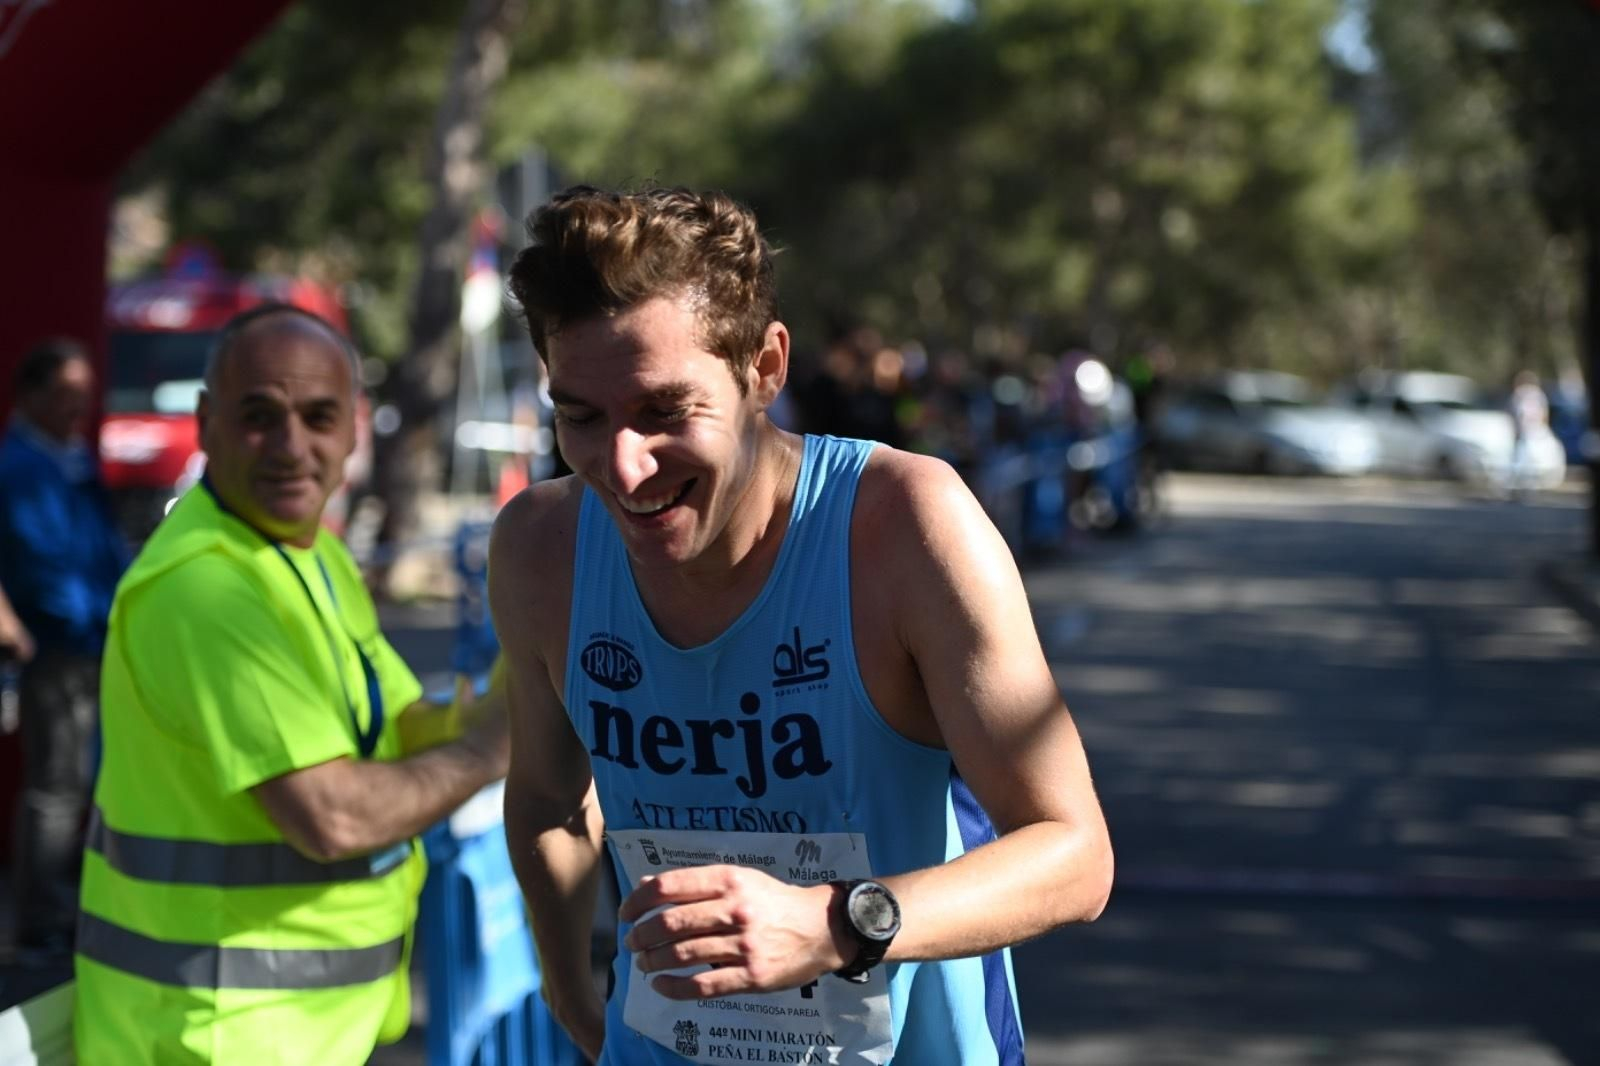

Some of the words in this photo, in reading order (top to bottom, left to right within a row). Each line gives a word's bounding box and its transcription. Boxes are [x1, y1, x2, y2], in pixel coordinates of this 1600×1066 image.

[589, 692, 832, 799] nerja
[632, 798, 808, 834] ATLETISMO
[723, 853, 736, 864] de
[737, 853, 776, 867] Málaga
[788, 867, 837, 882] Málaga
[744, 1003, 786, 1016] ORTIGOSA
[787, 1007, 820, 1018] PAREJA
[730, 1027, 763, 1042] MINI
[766, 1031, 837, 1046] MARATÓN
[709, 1043, 743, 1060] PEÑA
[747, 1047, 764, 1061] EL
